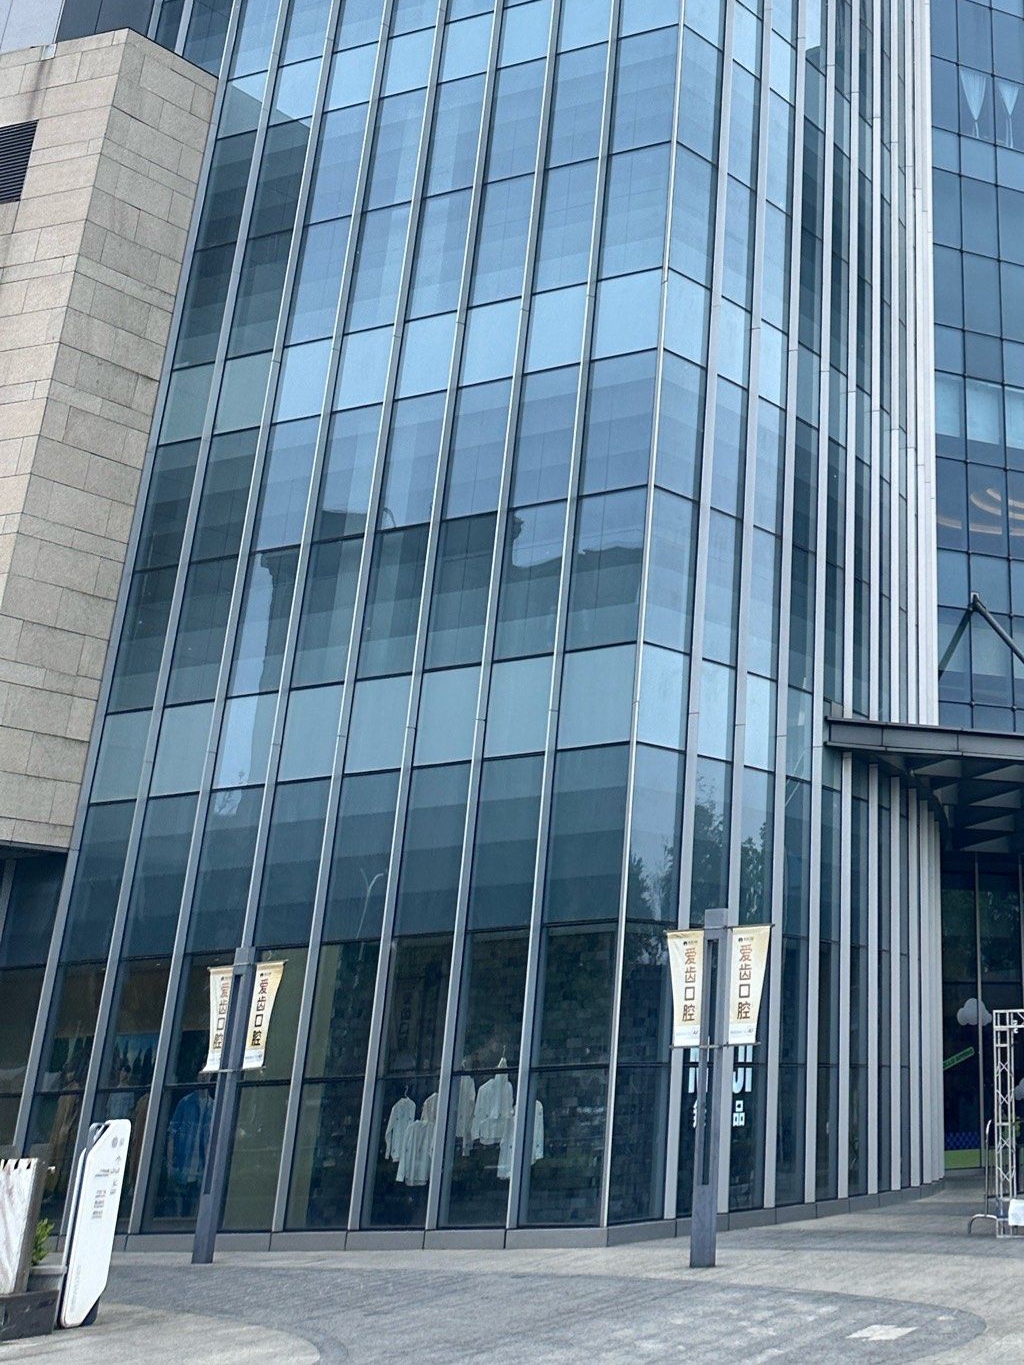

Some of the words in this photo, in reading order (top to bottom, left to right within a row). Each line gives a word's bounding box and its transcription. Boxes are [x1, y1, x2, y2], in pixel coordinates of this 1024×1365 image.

[251, 978, 269, 1047] 爱齿口腔
[682, 948, 697, 1022] 爱齿口腔
[737, 944, 753, 1020] 爱齿口腔
